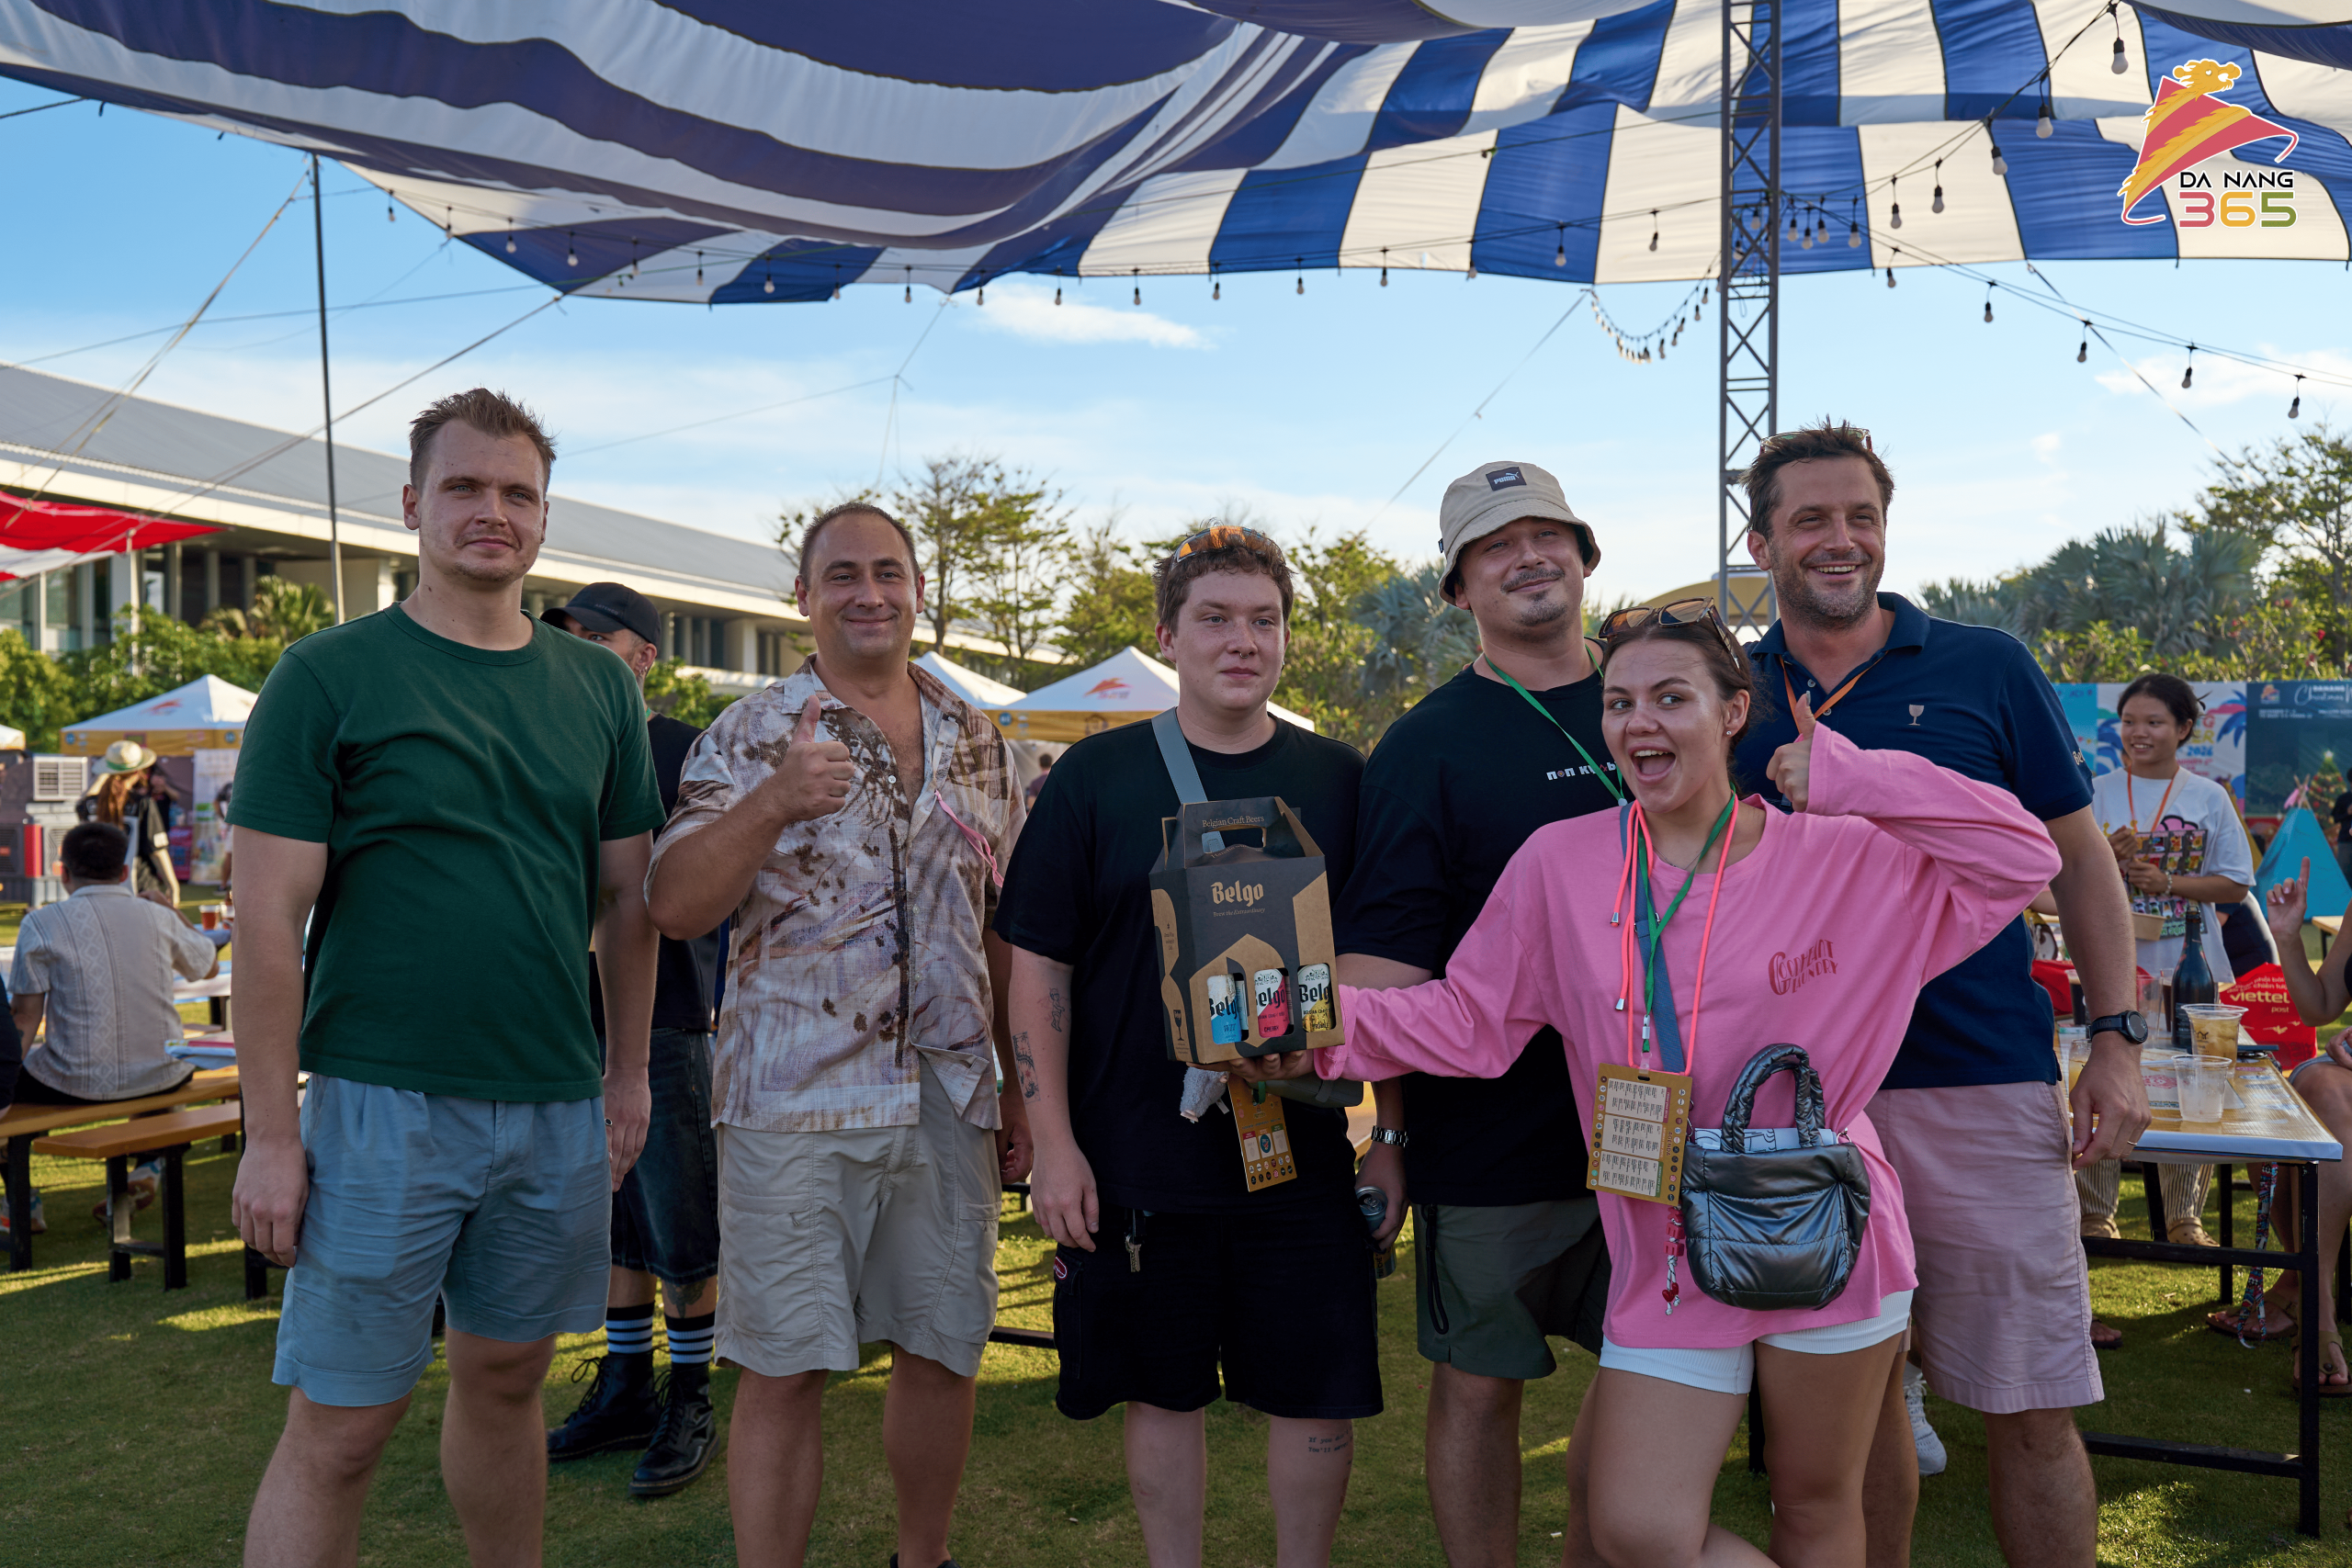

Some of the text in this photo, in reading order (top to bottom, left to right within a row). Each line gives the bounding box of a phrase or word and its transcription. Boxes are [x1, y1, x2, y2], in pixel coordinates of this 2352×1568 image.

[1493, 475, 1517, 485] PUMA
[2187, 745, 2214, 757] 2026
[1202, 815, 1265, 829] Belgian Craft Beers
[1210, 879, 1264, 908] Belgo
[1255, 987, 1285, 1009] elgo
[2229, 990, 2290, 1004] viettel
[2271, 1006, 2290, 1014] post
